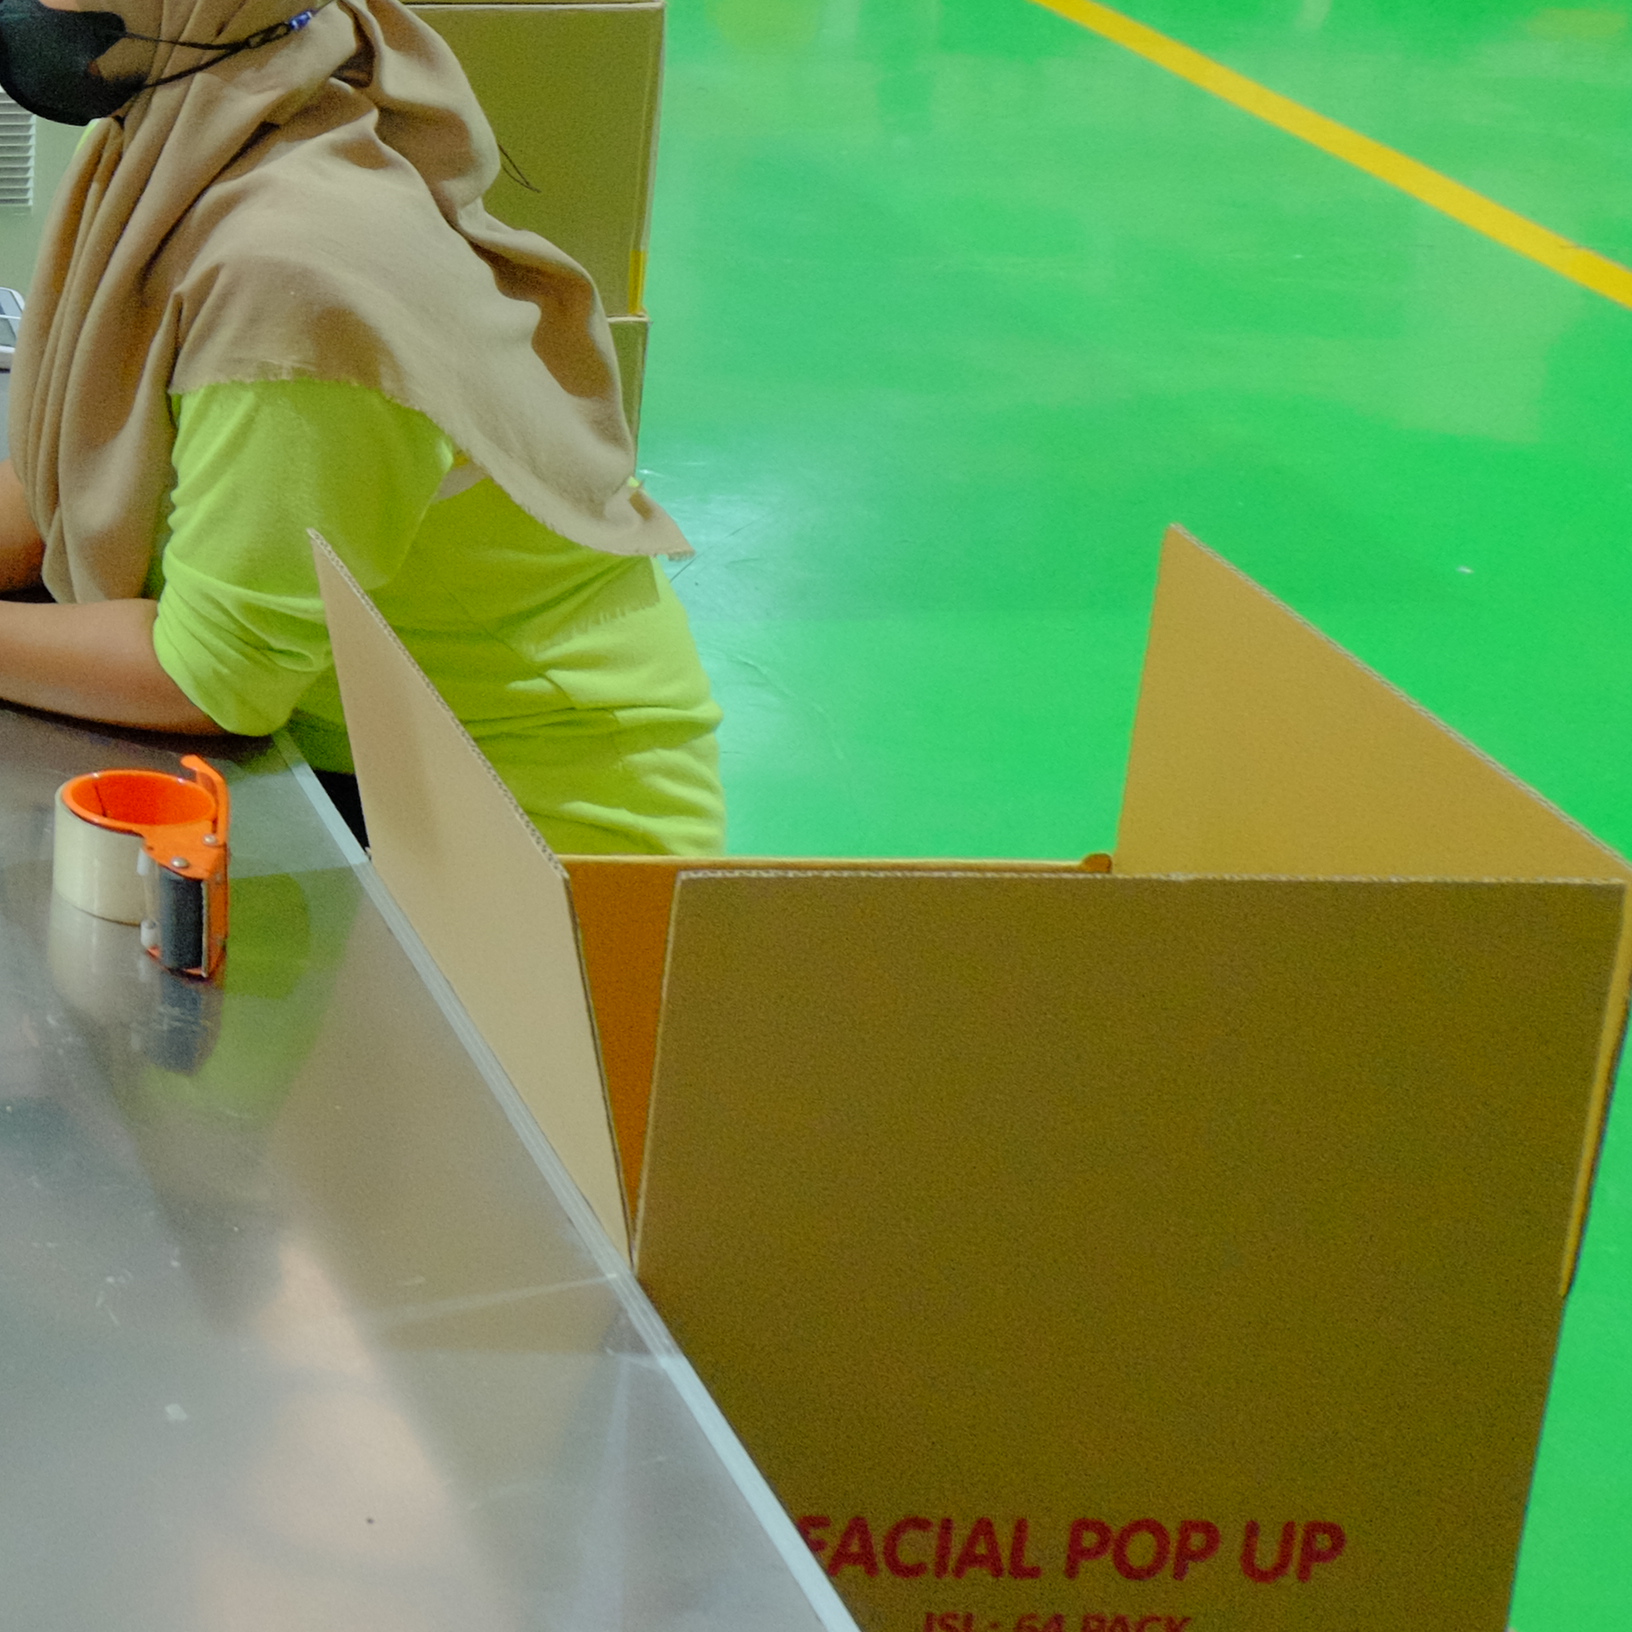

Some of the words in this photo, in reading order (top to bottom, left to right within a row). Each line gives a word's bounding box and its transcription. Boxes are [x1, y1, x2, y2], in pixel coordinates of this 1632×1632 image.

[796, 1516, 1043, 1579] FACIAL
[1063, 1517, 1221, 1581] POP
[1239, 1519, 1348, 1583] UP
